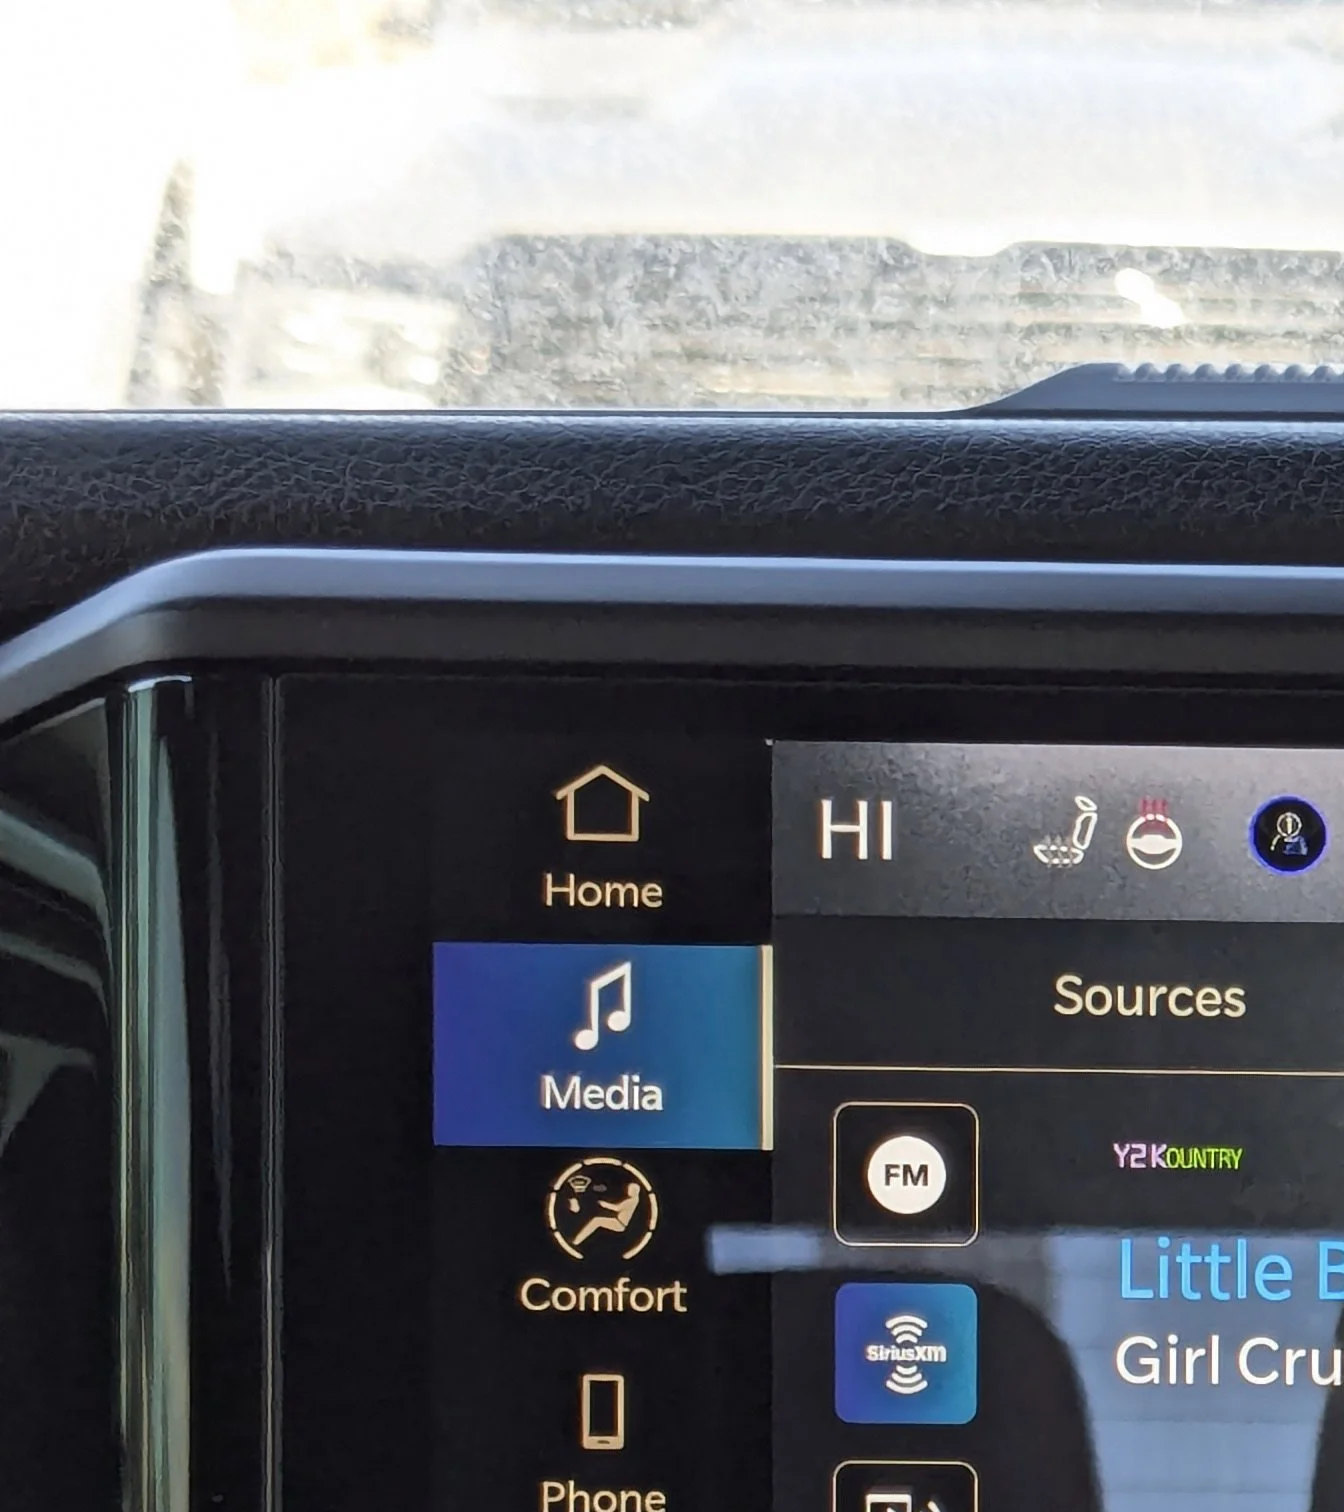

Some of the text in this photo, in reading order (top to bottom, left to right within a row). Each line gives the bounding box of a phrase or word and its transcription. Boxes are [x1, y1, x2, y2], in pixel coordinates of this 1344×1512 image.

[819, 798, 894, 861] HI
[543, 872, 664, 909] Home
[1053, 973, 1248, 1018] Sources
[540, 1073, 664, 1112] Media
[884, 1164, 930, 1189] FM
[1119, 1236, 1294, 1302] Little
[519, 1276, 688, 1315] Comfort
[1115, 1333, 1221, 1386] Girl
